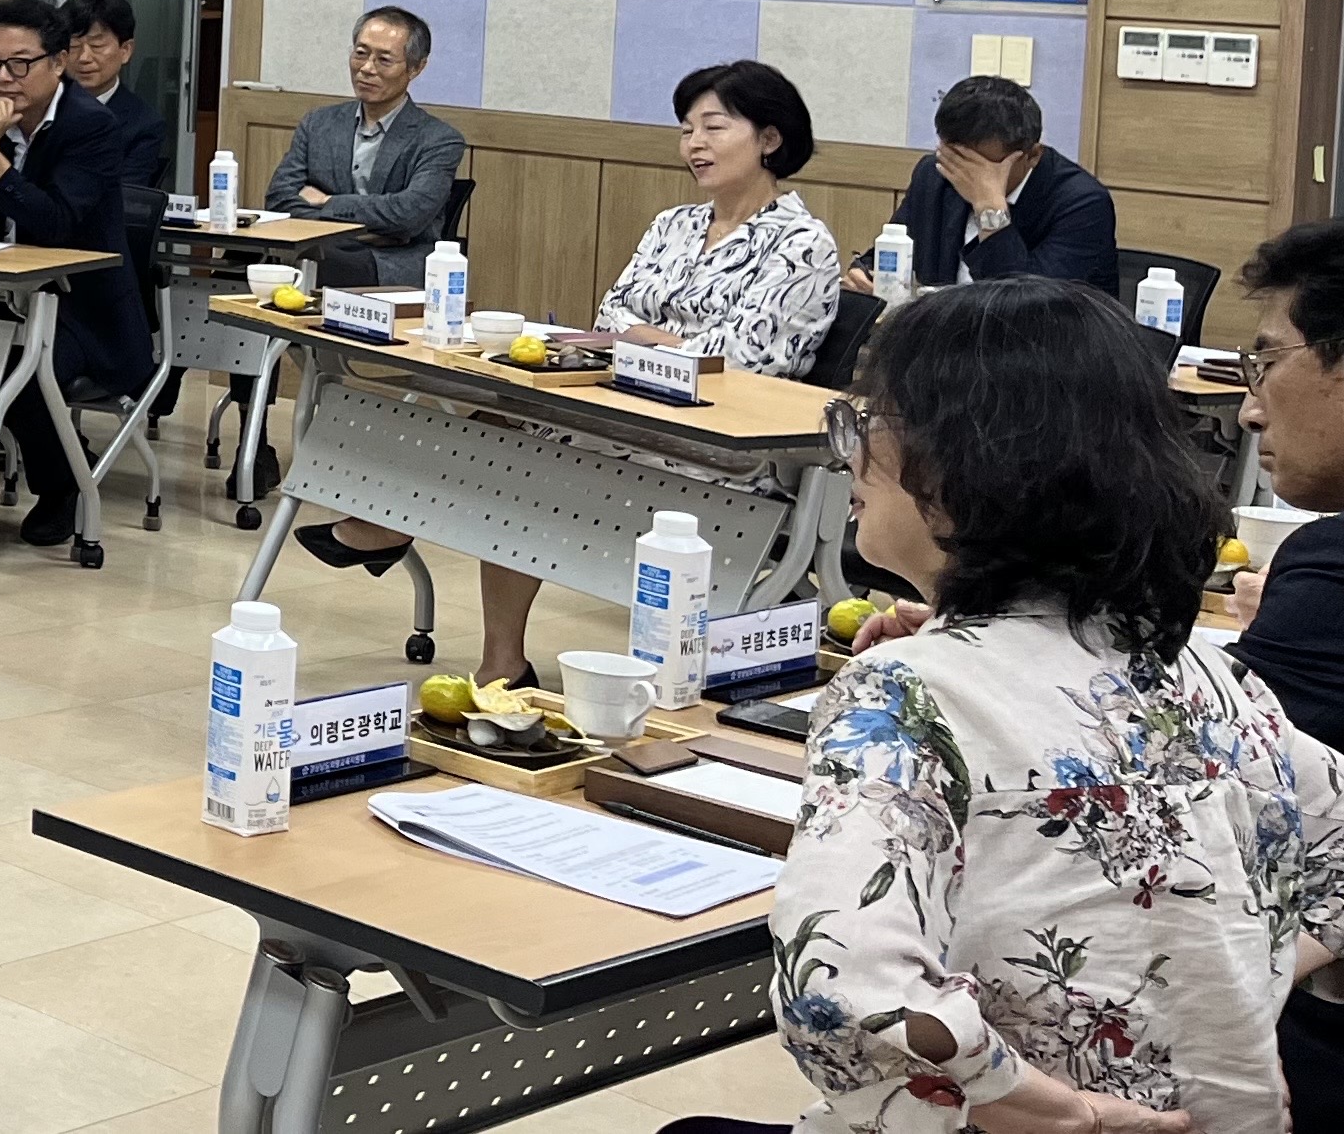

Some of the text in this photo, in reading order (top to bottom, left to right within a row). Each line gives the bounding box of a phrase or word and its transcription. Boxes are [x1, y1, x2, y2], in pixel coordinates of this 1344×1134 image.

[741, 622, 813, 655] 부림초등학교
[276, 718, 293, 749] 물
[309, 708, 403, 746] 의령은광학교
[254, 740, 274, 752] DEEP
[254, 750, 292, 772] WATER
